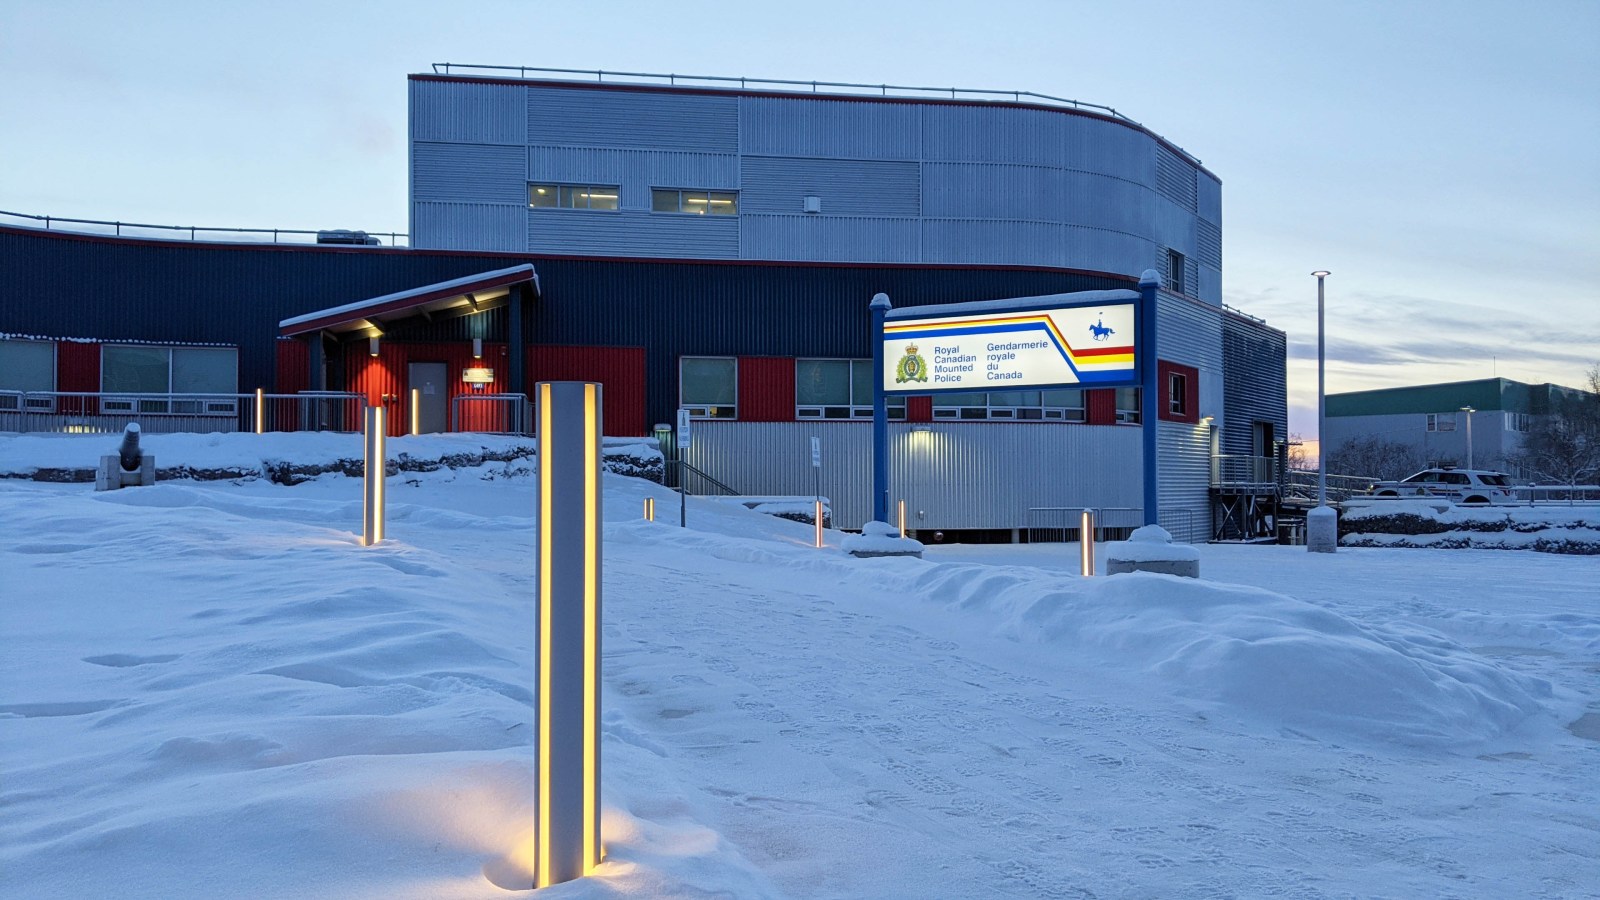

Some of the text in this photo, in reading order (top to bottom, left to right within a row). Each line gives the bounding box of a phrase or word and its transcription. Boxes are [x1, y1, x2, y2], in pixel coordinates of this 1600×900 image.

[934, 345, 960, 355] Royal
[986, 340, 1048, 352] Gendarmerie
[934, 355, 977, 364] Canadian
[986, 351, 1016, 361] royale
[934, 364, 973, 373] Mounted
[986, 363, 999, 371] du
[934, 374, 962, 383] Police
[986, 371, 1023, 380] Canada
